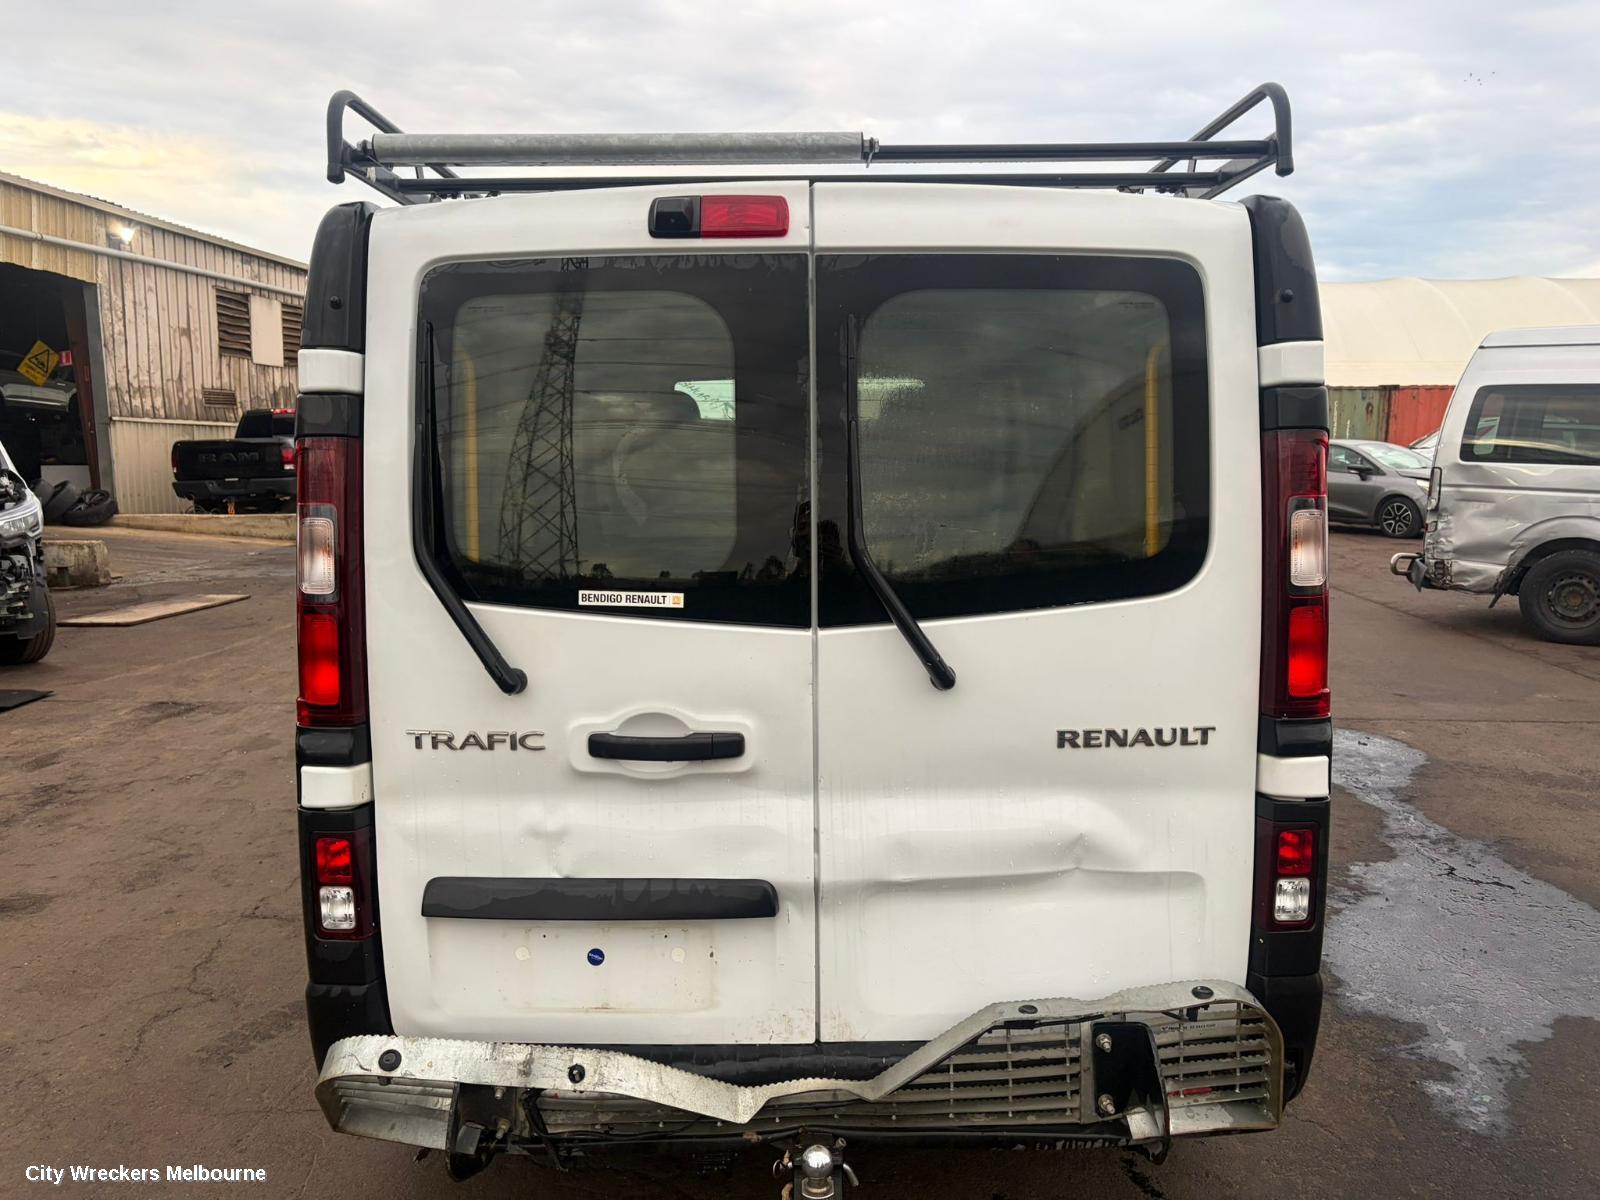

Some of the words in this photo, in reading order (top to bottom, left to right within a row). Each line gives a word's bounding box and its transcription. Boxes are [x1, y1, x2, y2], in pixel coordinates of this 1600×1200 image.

[198, 450, 261, 464] RAM
[581, 593, 622, 603] BENDIGO
[625, 594, 667, 604] RENAULT
[405, 729, 546, 751] TRAFIC
[1056, 726, 1216, 749] RENAULT
